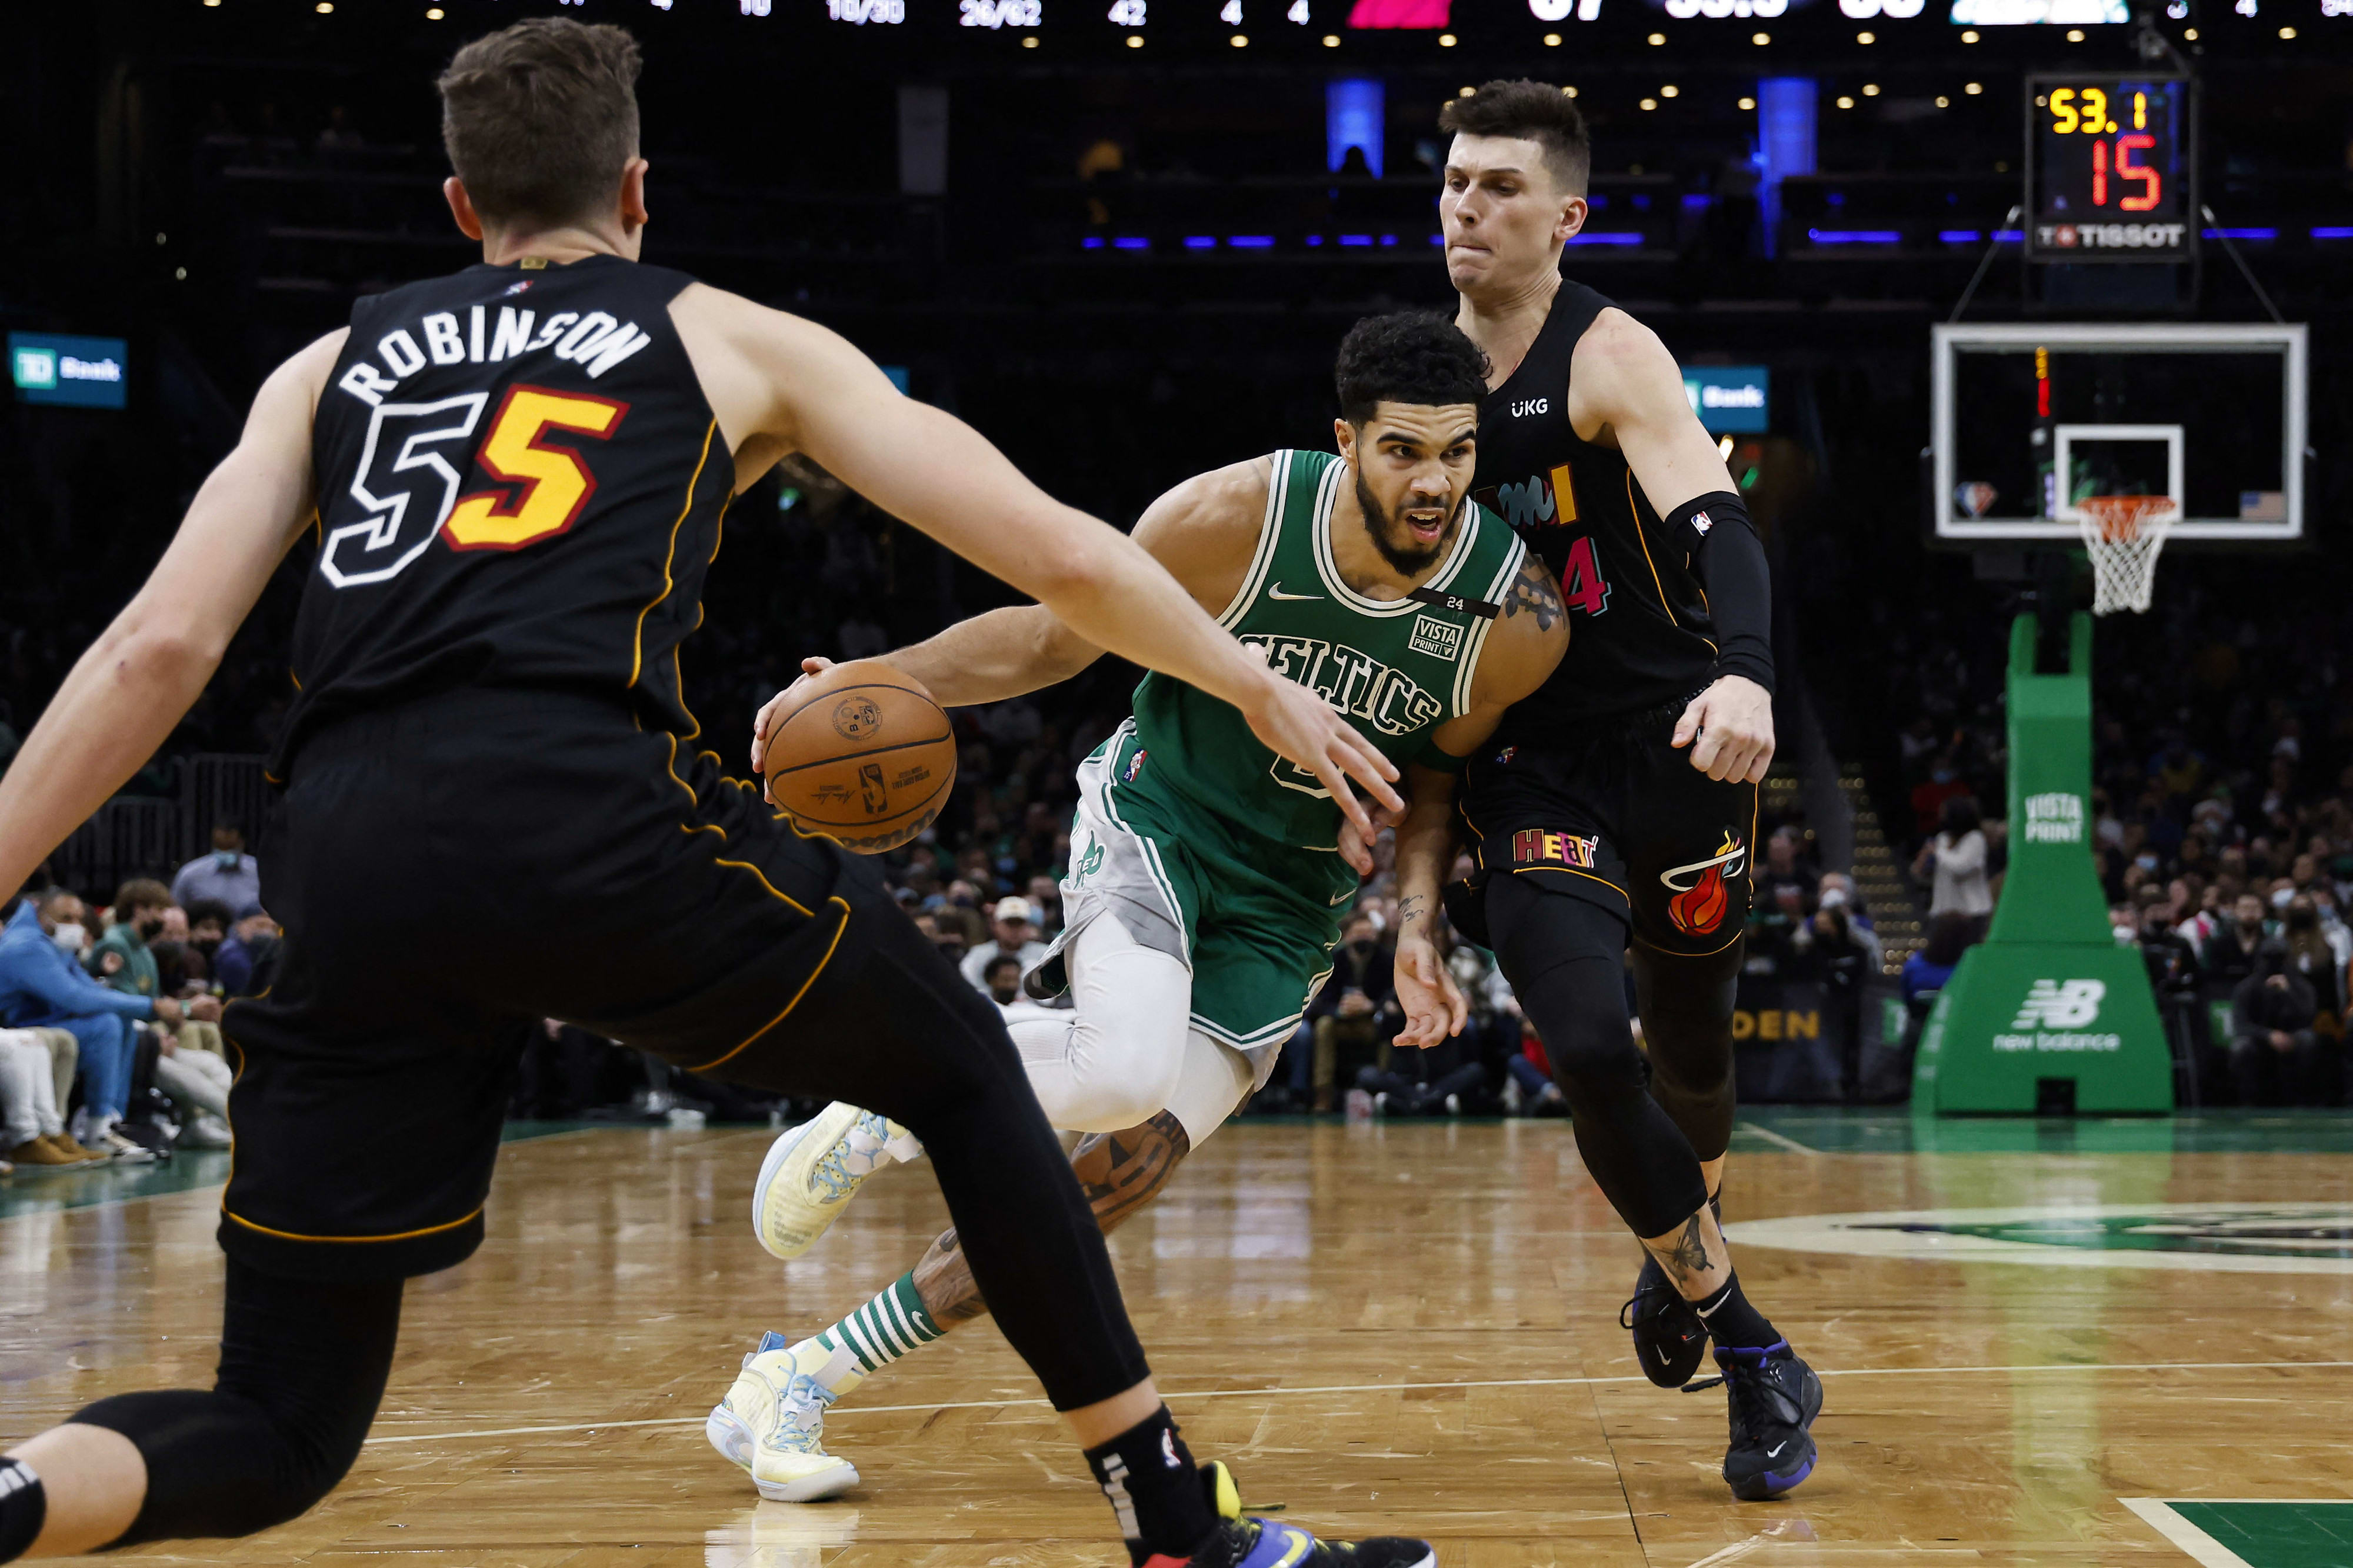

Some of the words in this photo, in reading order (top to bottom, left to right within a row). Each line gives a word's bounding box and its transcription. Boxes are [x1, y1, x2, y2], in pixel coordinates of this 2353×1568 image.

[2049, 88, 2147, 134] 53.1
[2093, 135, 2161, 211] 15
[2077, 224, 2185, 247] TISSOT
[339, 305, 651, 407] ROBINSON
[320, 383, 631, 588] 55
[1447, 596, 1464, 610] 24
[1414, 638, 1440, 653] PRINT
[1420, 620, 1457, 645] VISTA
[2025, 792, 2083, 819] VISTA
[1992, 1034, 2034, 1051] new
[2037, 1030, 2121, 1052] balance
